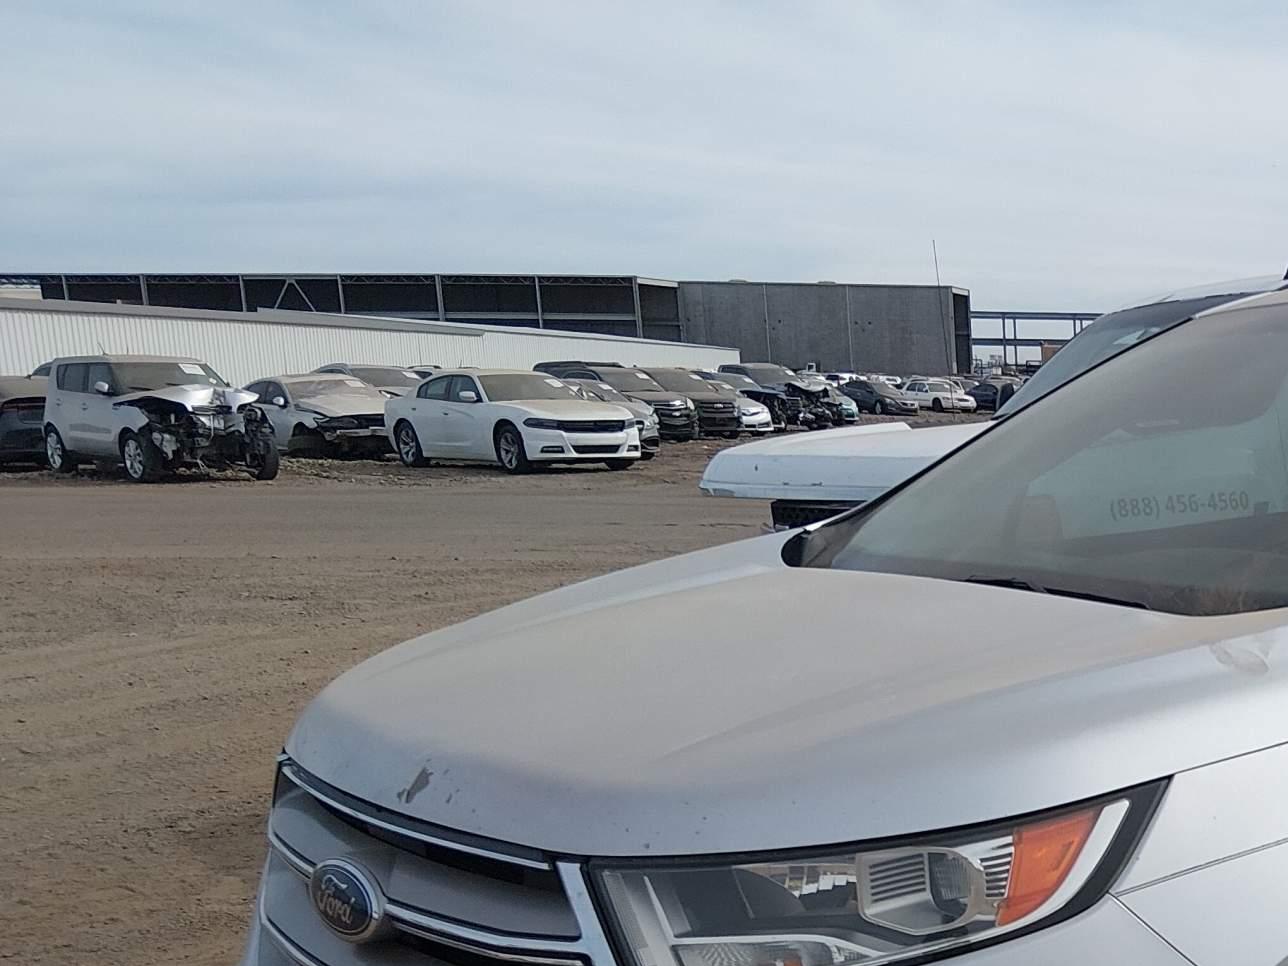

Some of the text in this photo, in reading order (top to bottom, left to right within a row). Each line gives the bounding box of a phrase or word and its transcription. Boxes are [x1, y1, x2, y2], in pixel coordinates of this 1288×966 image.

[1110, 491, 1250, 521] (888) 456-4560
[318, 874, 356, 925] Ford
